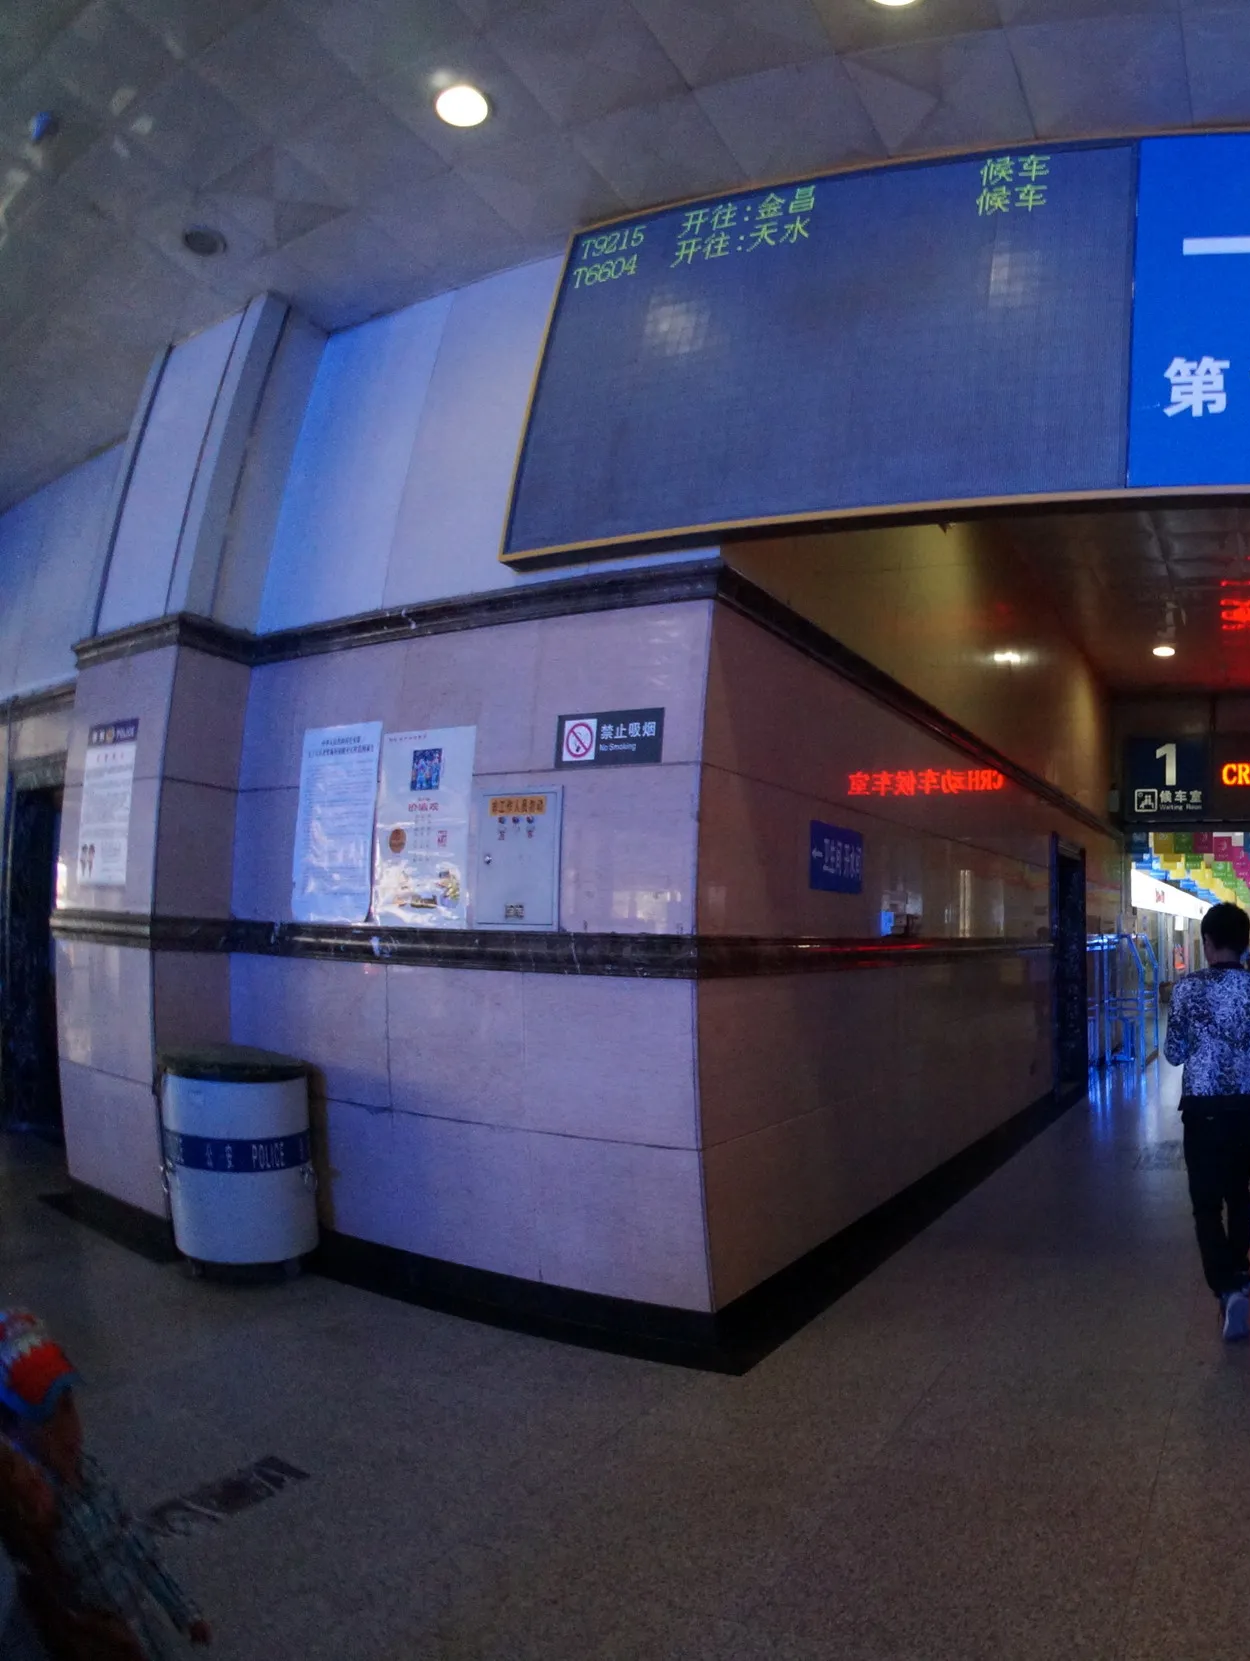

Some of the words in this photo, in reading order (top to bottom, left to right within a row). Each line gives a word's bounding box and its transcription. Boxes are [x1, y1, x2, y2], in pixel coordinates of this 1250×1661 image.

[582, 224, 647, 260] T9215
[677, 184, 816, 239] 开往:金昌
[980, 153, 1051, 187] 候车
[573, 253, 638, 289] T6604
[669, 216, 811, 269] 开往:天水
[975, 184, 1048, 217] 候车
[600, 721, 657, 740] 禁止吸烟
[599, 743, 609, 752] No
[610, 741, 637, 752] Smoking
[1156, 743, 1177, 786] 1
[1159, 789, 1202, 803] 候车室
[251, 1142, 286, 1170] POLICE
